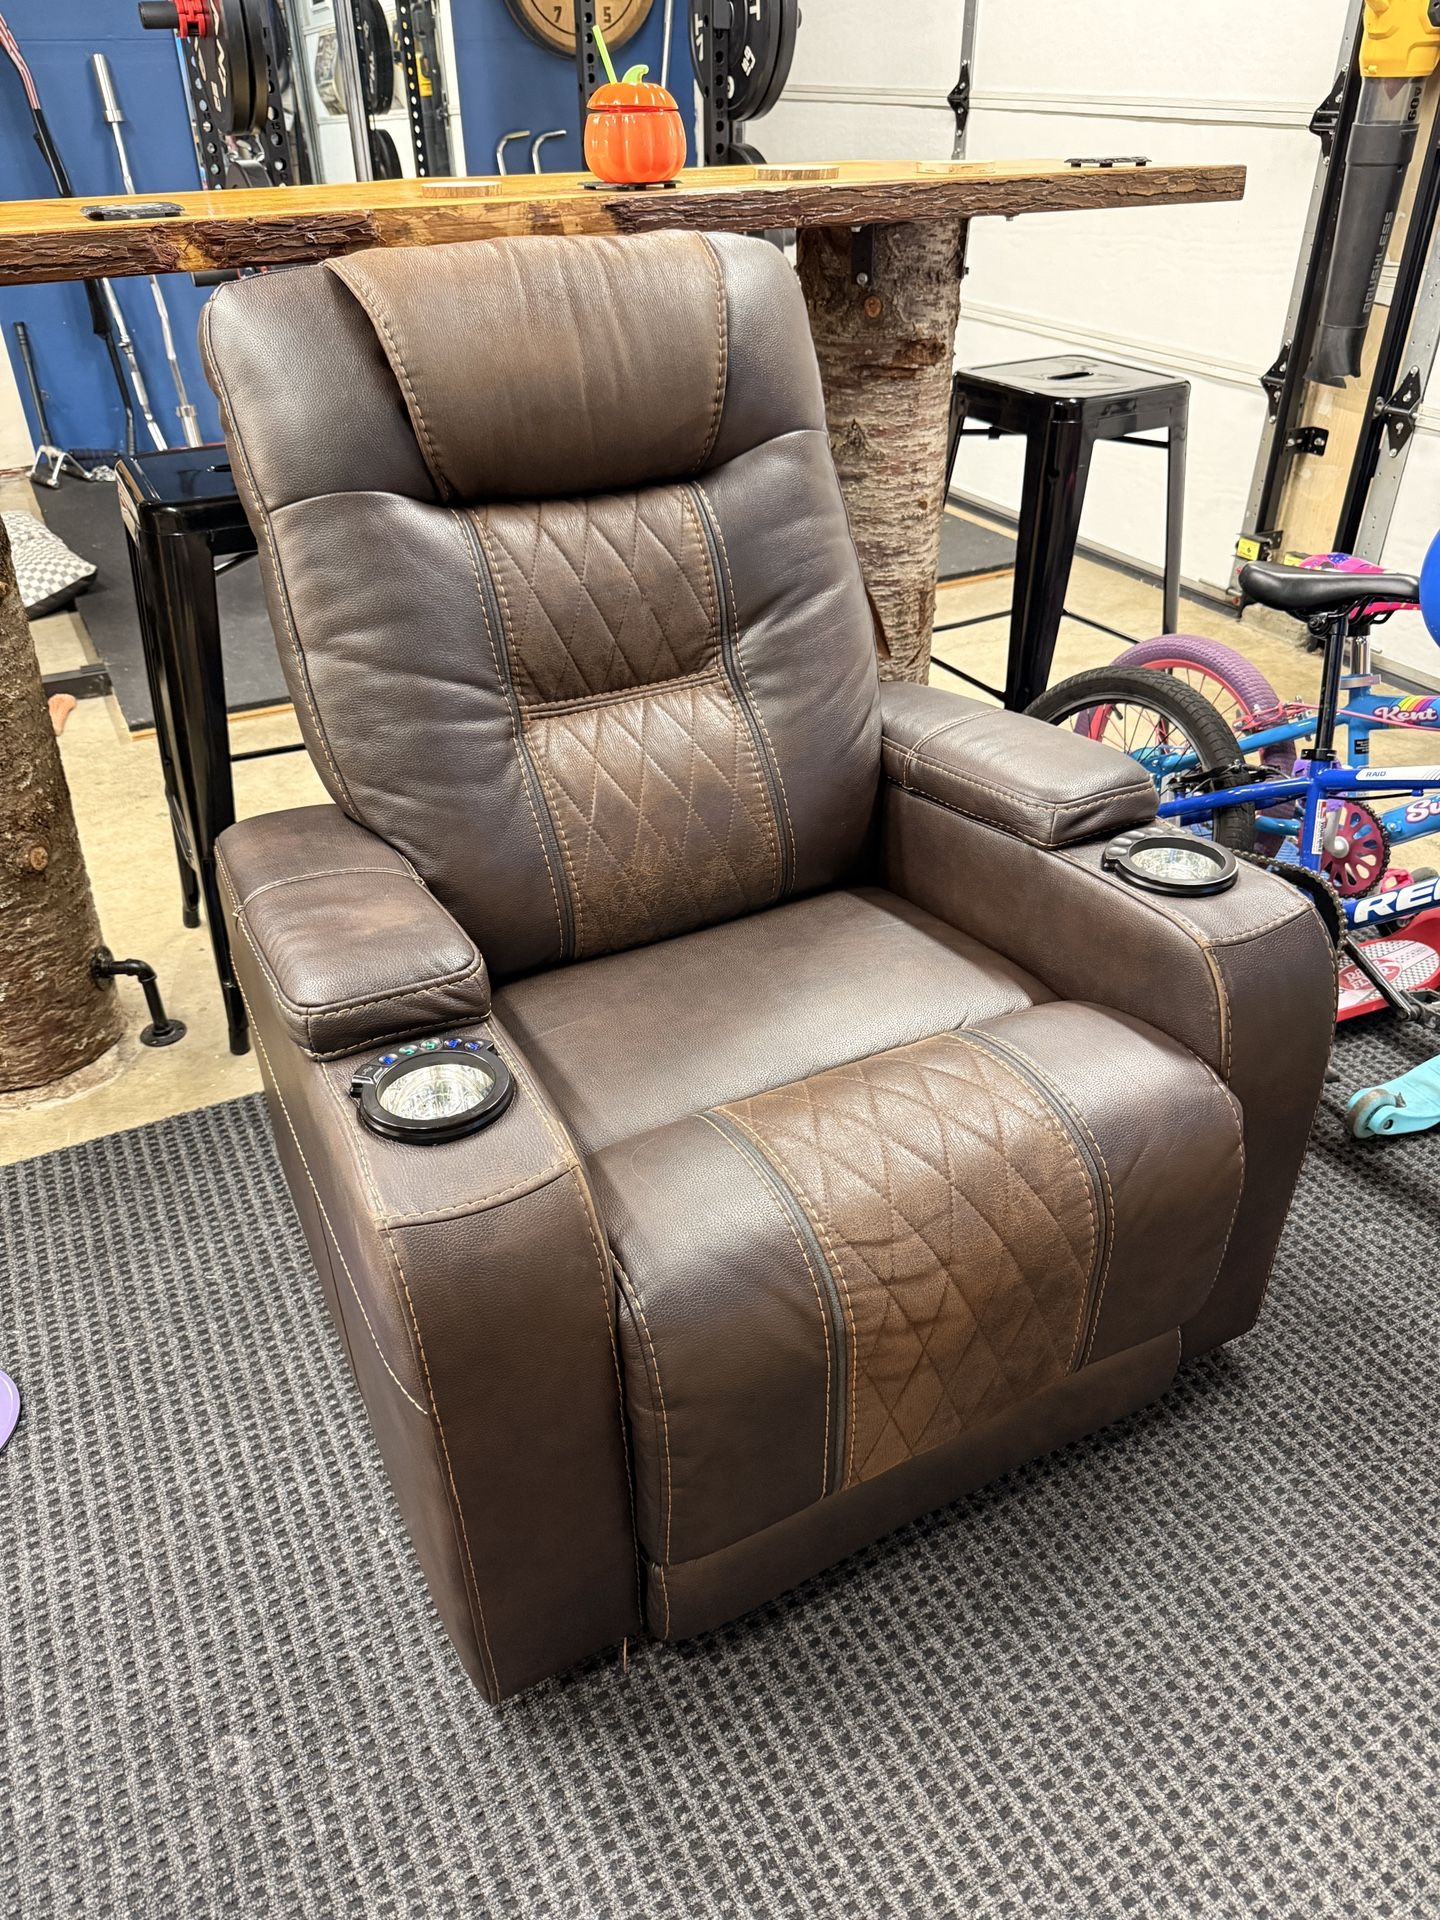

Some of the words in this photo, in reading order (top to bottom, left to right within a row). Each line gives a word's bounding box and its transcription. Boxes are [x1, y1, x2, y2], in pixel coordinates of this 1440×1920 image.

[553, 6, 562, 23] 7
[603, 6, 612, 23] 5
[271, 122, 281, 130] 15
[1363, 211, 1393, 313] BRUSHLESS
[1374, 706, 1438, 721] Kent
[1354, 877, 1440, 923] RE
